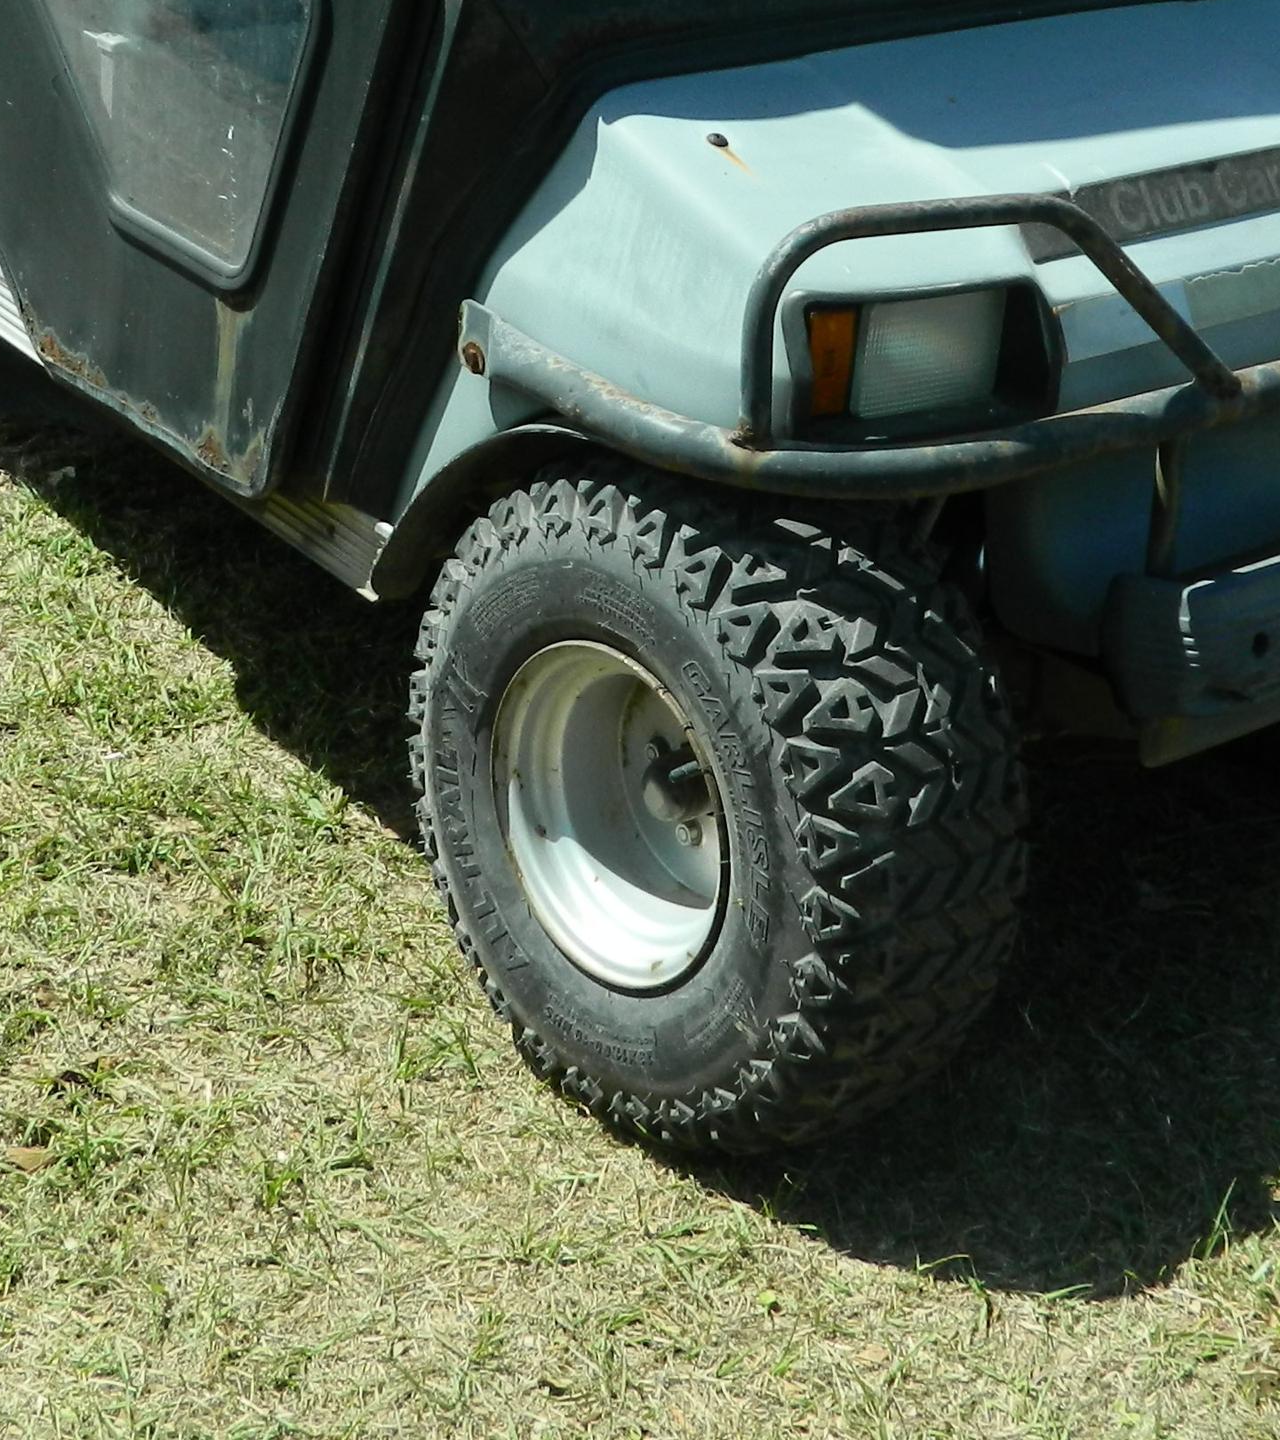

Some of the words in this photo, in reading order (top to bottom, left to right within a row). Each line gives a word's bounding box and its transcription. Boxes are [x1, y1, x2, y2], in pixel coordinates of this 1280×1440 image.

[1108, 170, 1210, 233] Club
[681, 660, 770, 944] CARLISLE
[472, 888, 530, 972] ALL
